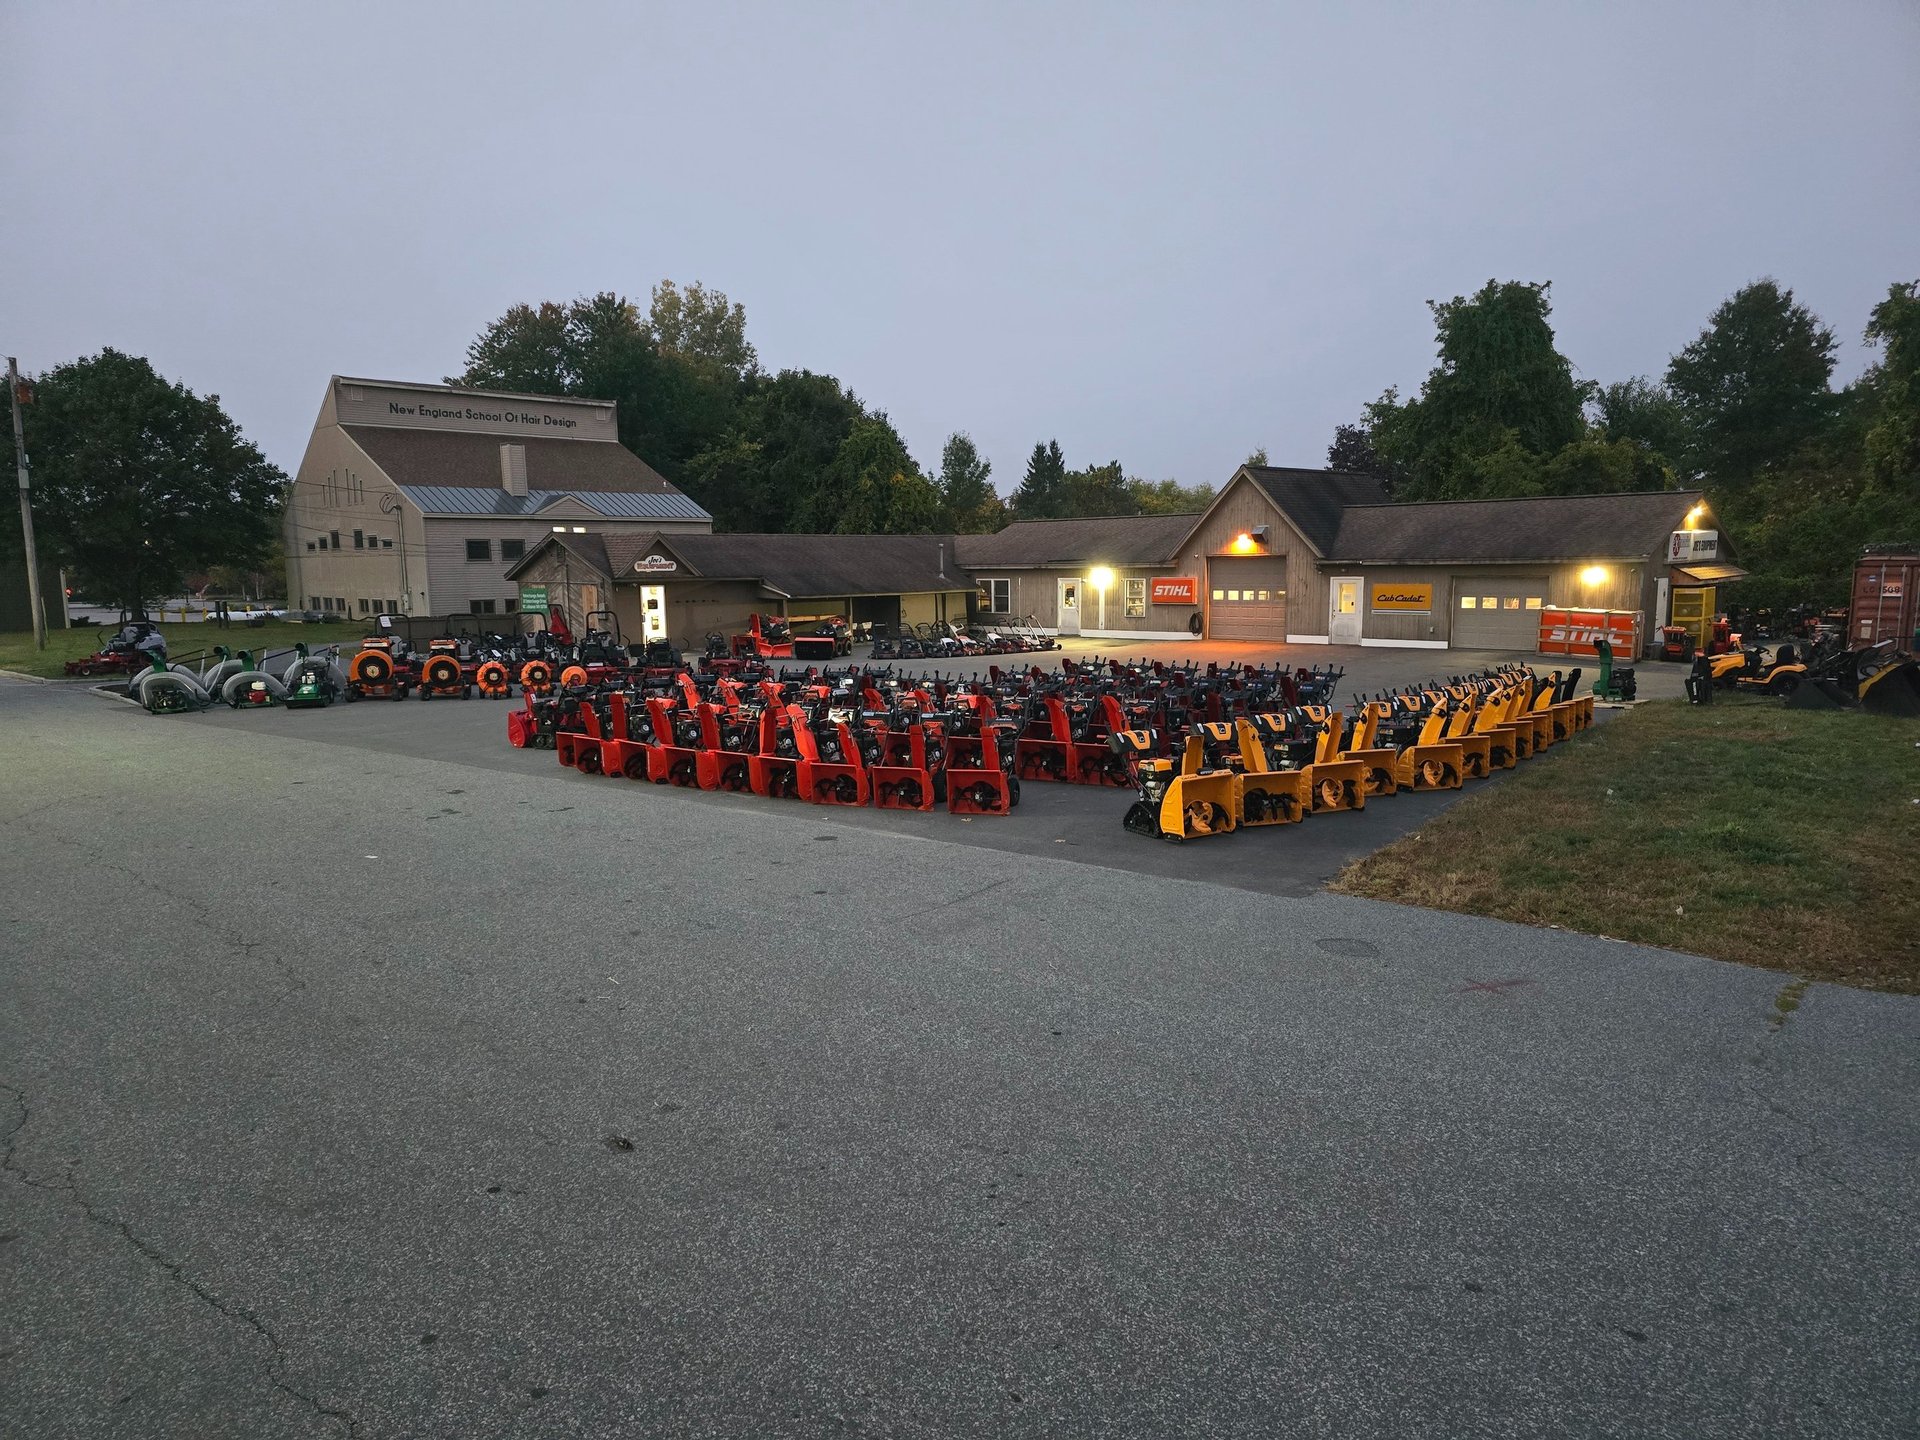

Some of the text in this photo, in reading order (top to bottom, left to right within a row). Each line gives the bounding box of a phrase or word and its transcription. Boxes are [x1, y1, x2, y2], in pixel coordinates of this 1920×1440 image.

[389, 402, 577, 428] New England School Of Hair Design
[1153, 585, 1191, 596] STIHL
[1377, 594, 1425, 602] Cub Cadet
